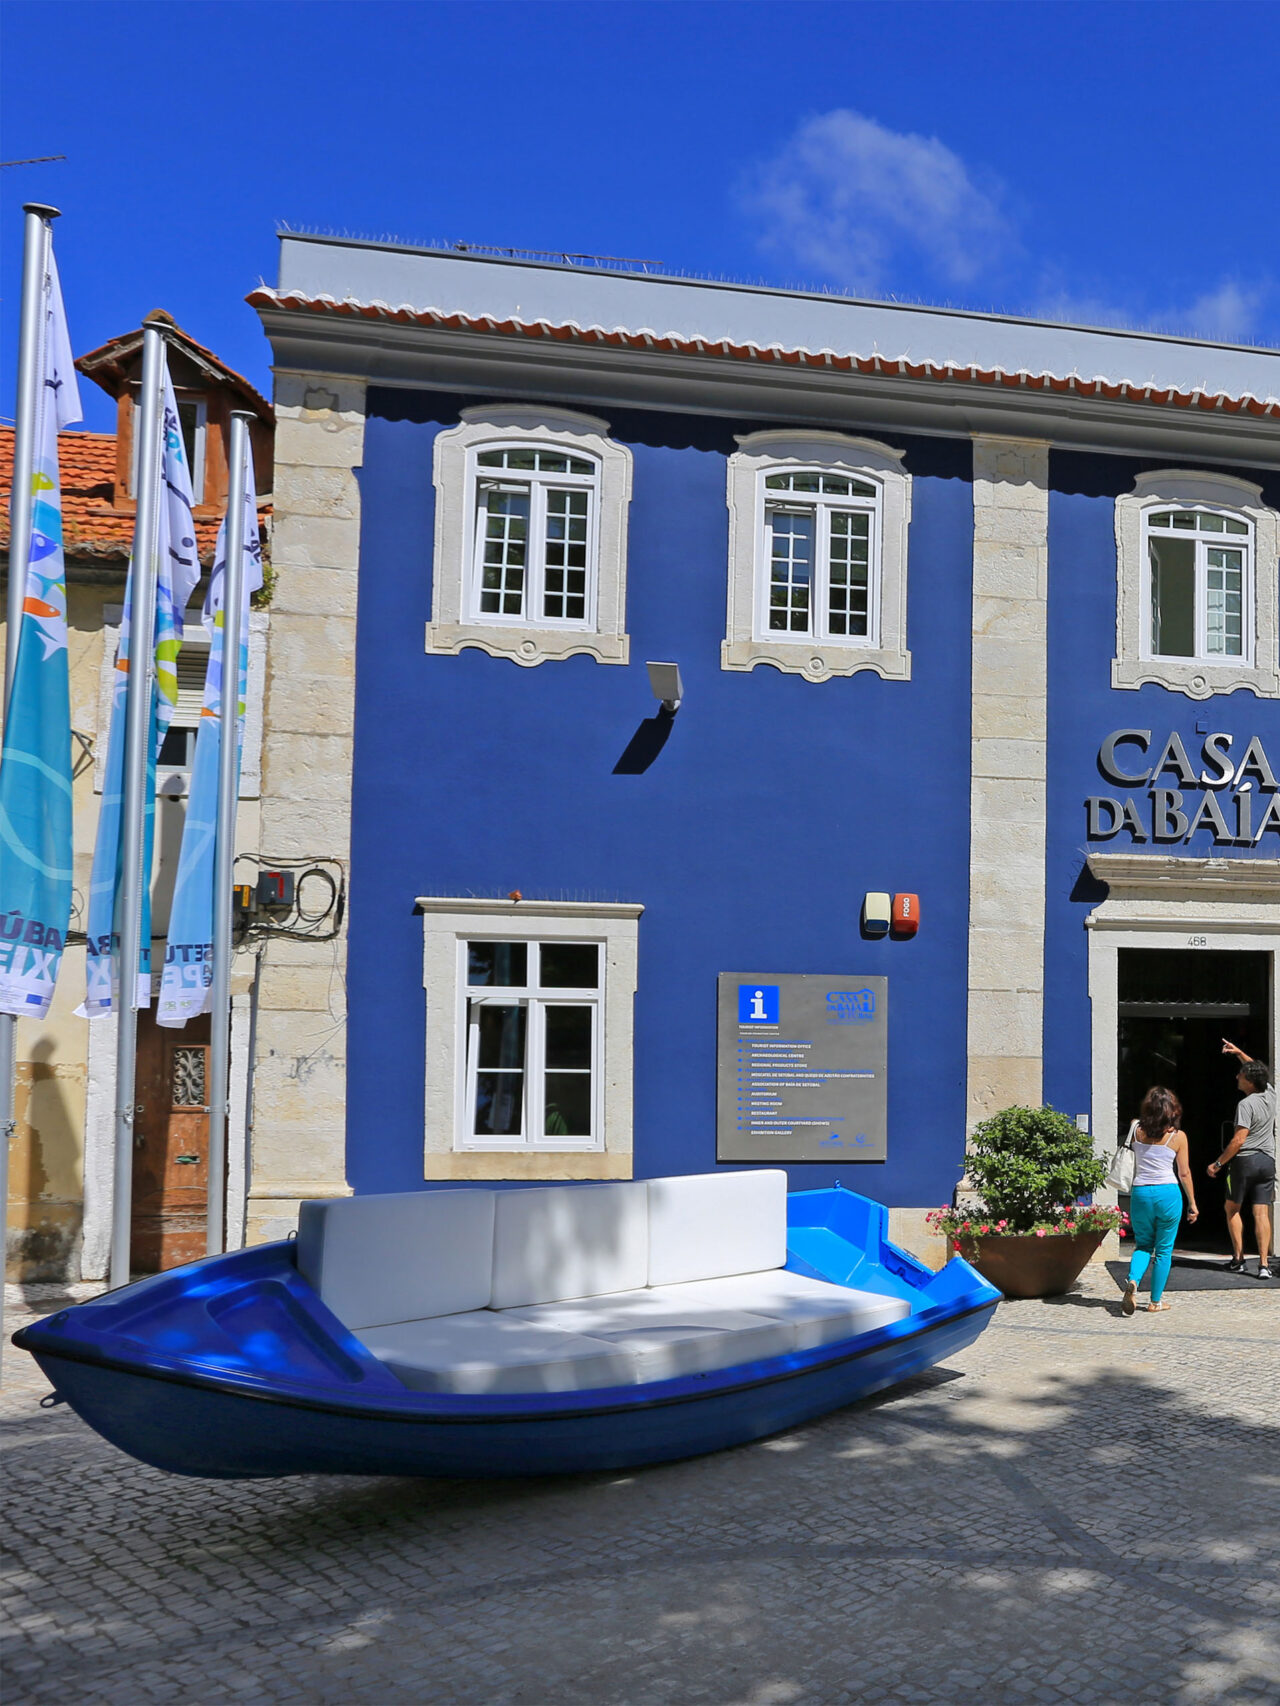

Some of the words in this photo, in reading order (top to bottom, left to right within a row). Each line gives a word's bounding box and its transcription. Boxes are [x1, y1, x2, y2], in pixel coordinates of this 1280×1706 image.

[1099, 728, 1280, 788] CASA
[1087, 796, 1150, 837] DA
[1187, 936, 1207, 947] 468
